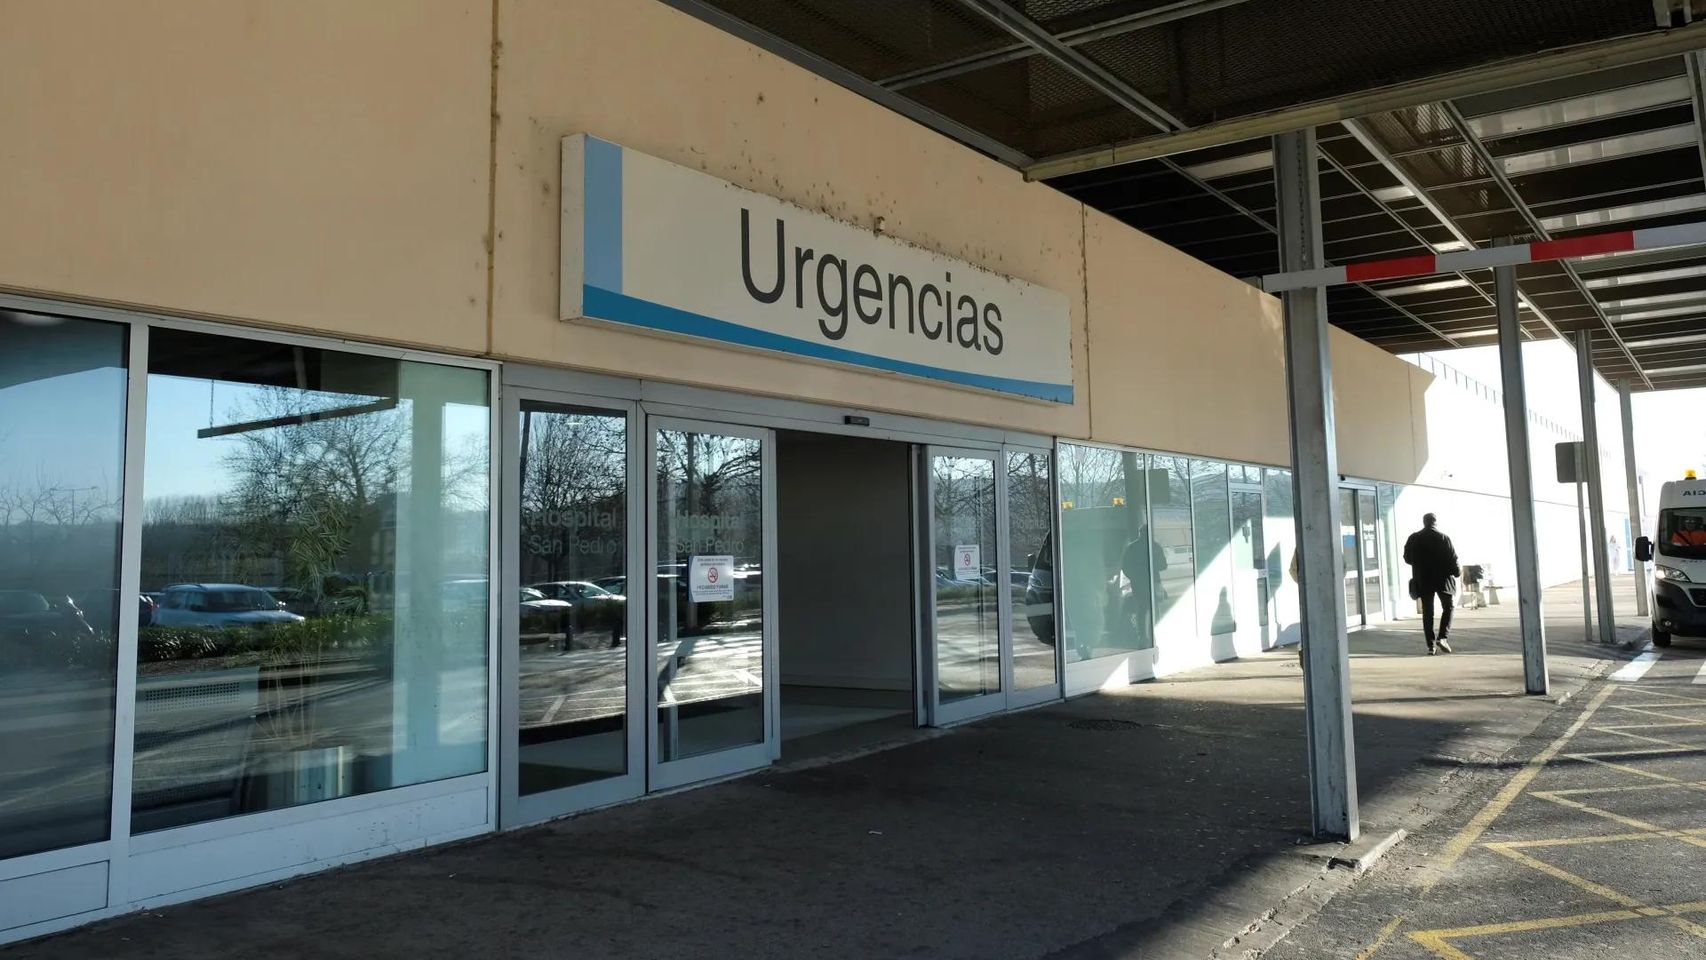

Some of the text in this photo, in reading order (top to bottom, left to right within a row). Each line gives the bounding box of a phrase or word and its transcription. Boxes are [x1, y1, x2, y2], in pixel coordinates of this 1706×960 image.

[741, 207, 1004, 356] Urgencias
[530, 507, 616, 533] Hospital
[676, 509, 744, 534] Hospital
[528, 534, 617, 554] San Pedro
[676, 536, 744, 554] San Pedro
